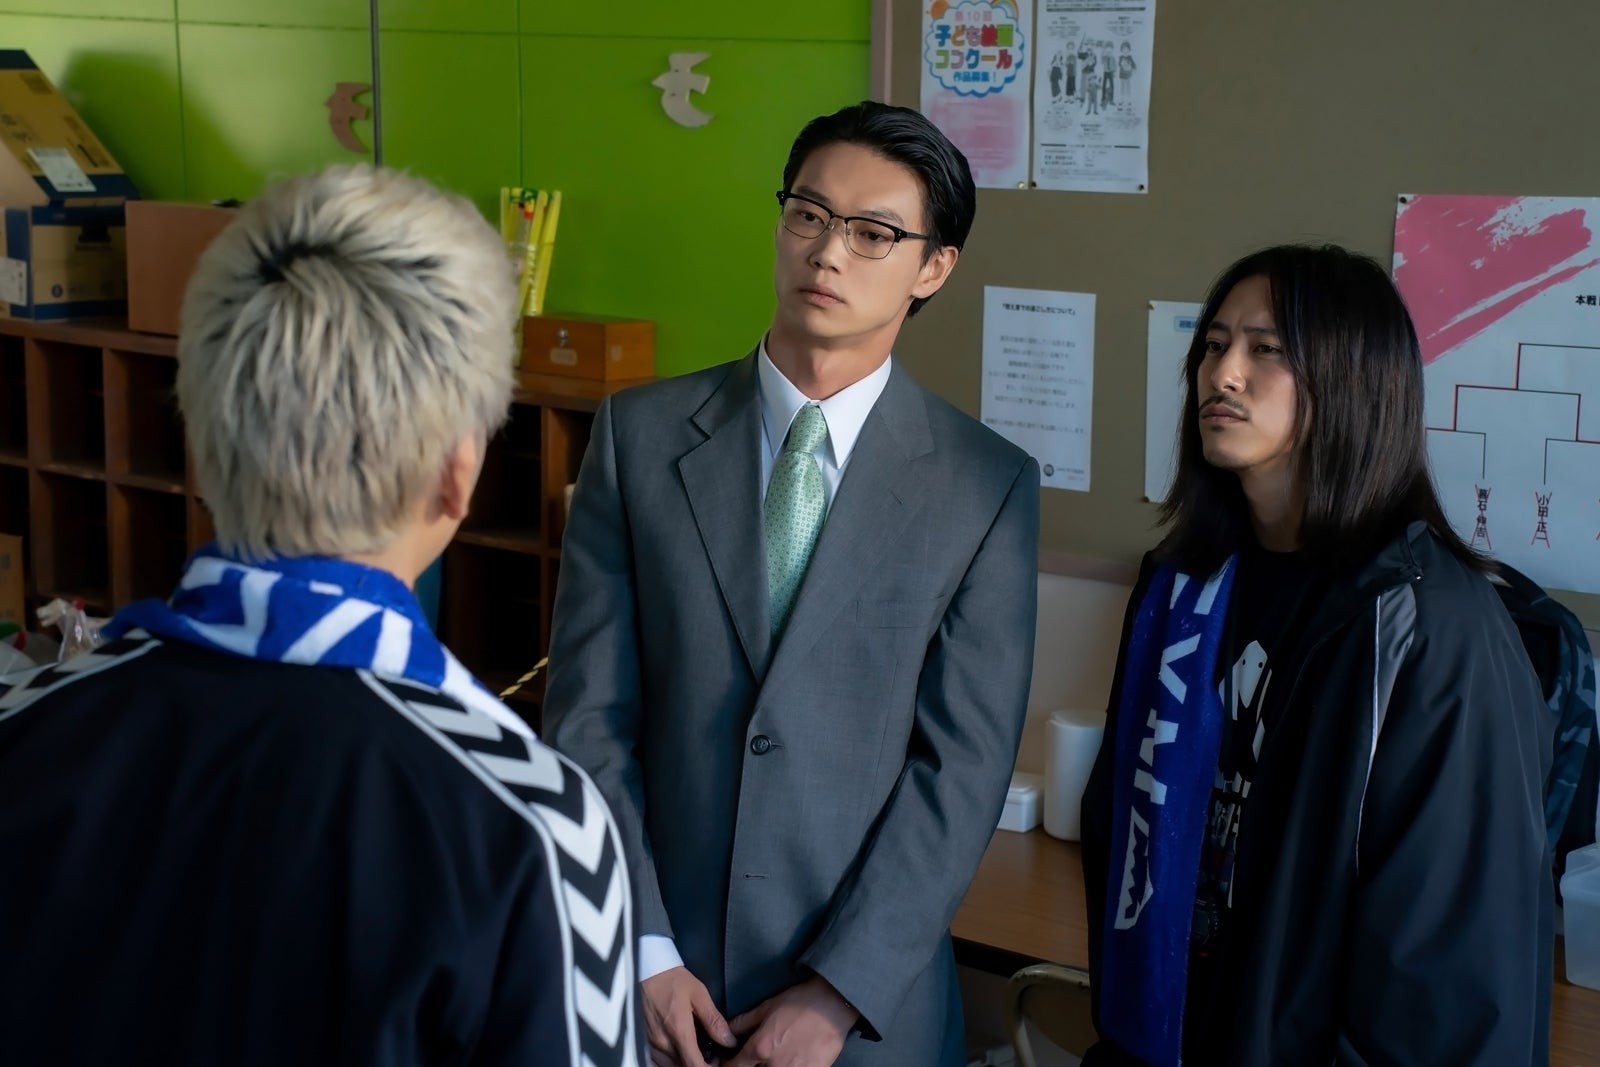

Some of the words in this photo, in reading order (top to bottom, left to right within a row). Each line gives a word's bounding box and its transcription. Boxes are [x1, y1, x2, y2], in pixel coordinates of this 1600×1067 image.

[935, 48, 1013, 69] コンクール
[1575, 294, 1600, 306] 本戦
